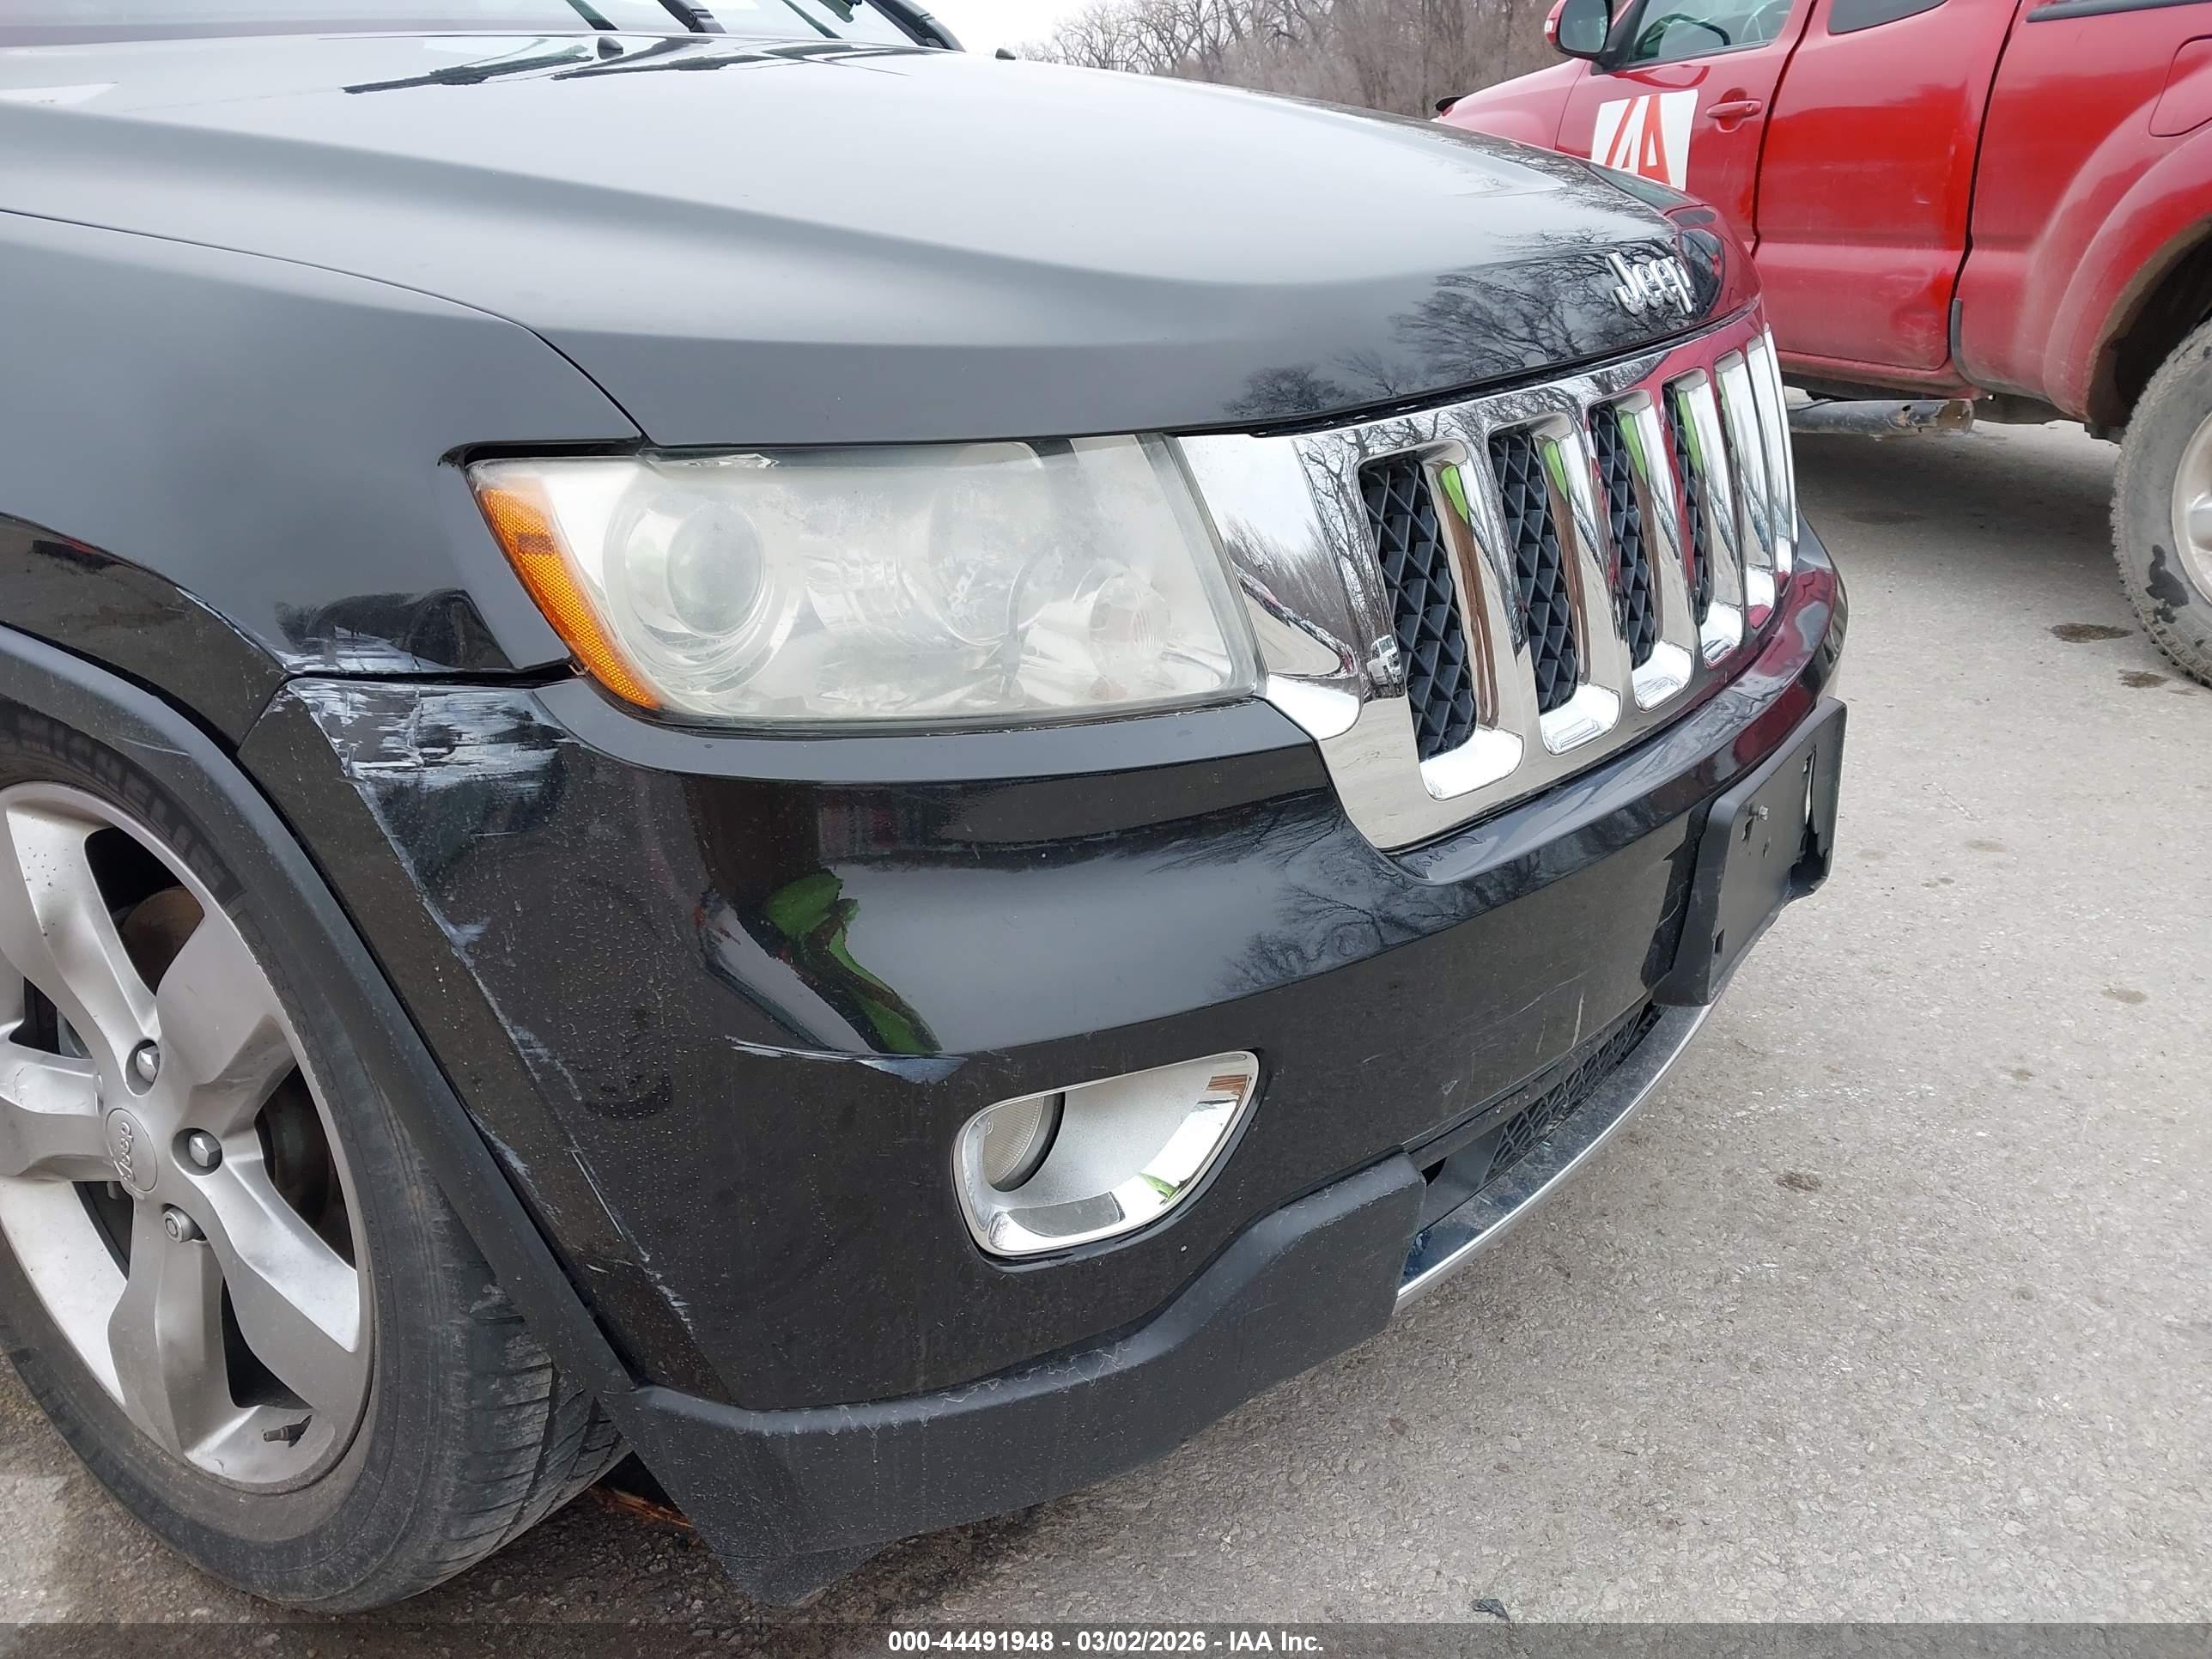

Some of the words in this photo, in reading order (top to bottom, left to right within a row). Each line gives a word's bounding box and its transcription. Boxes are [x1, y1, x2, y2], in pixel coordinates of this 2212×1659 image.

[1606, 252, 1692, 315] Jeep
[15, 713, 227, 890] MICHELIN
[113, 1121, 134, 1182] Jeep
